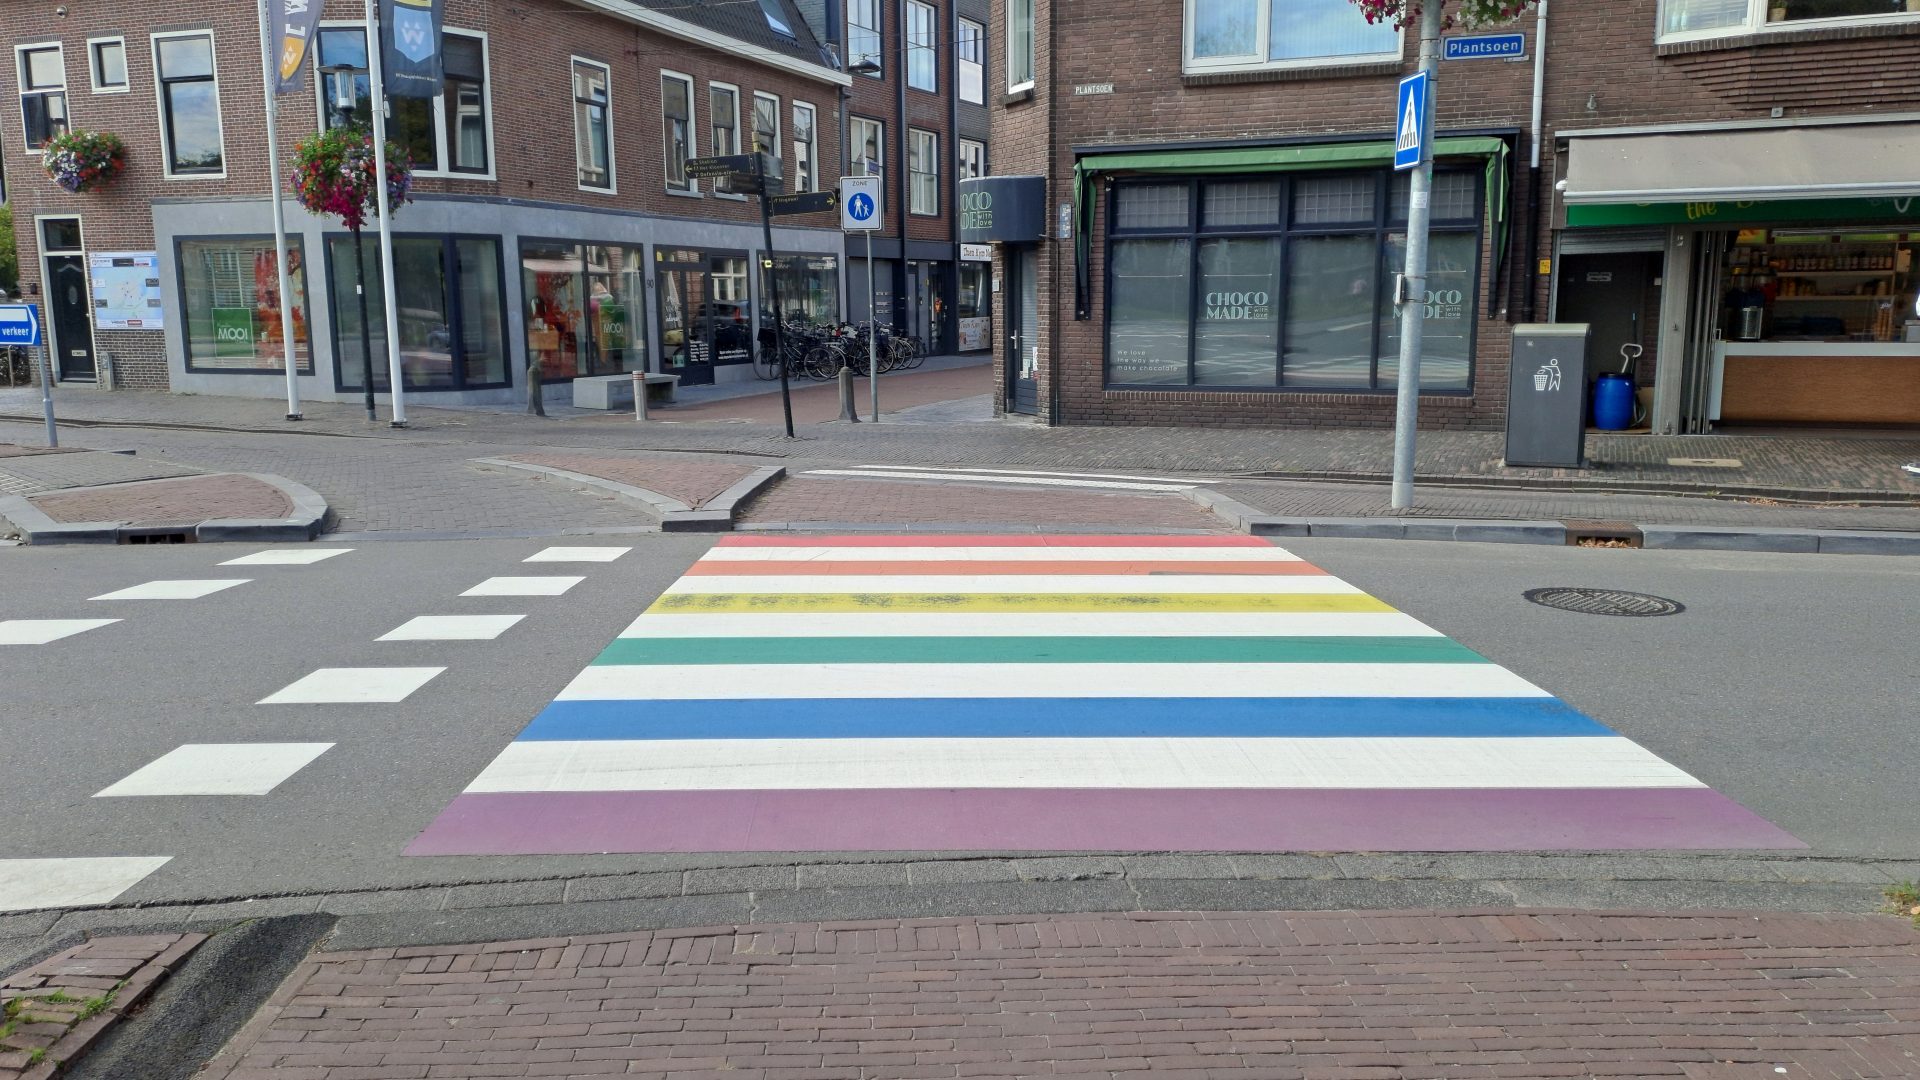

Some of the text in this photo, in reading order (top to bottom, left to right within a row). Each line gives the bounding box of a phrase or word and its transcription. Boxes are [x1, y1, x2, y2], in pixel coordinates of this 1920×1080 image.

[1450, 42, 1518, 54] Plantsoen
[1075, 84, 1113, 94] PLANTSOEN
[1206, 291, 1269, 306] CHOCO
[1206, 306, 1253, 320] MADE
[1392, 305, 1445, 319] MDE
[1, 326, 29, 336] verkeer
[218, 327, 248, 340] MOOI
